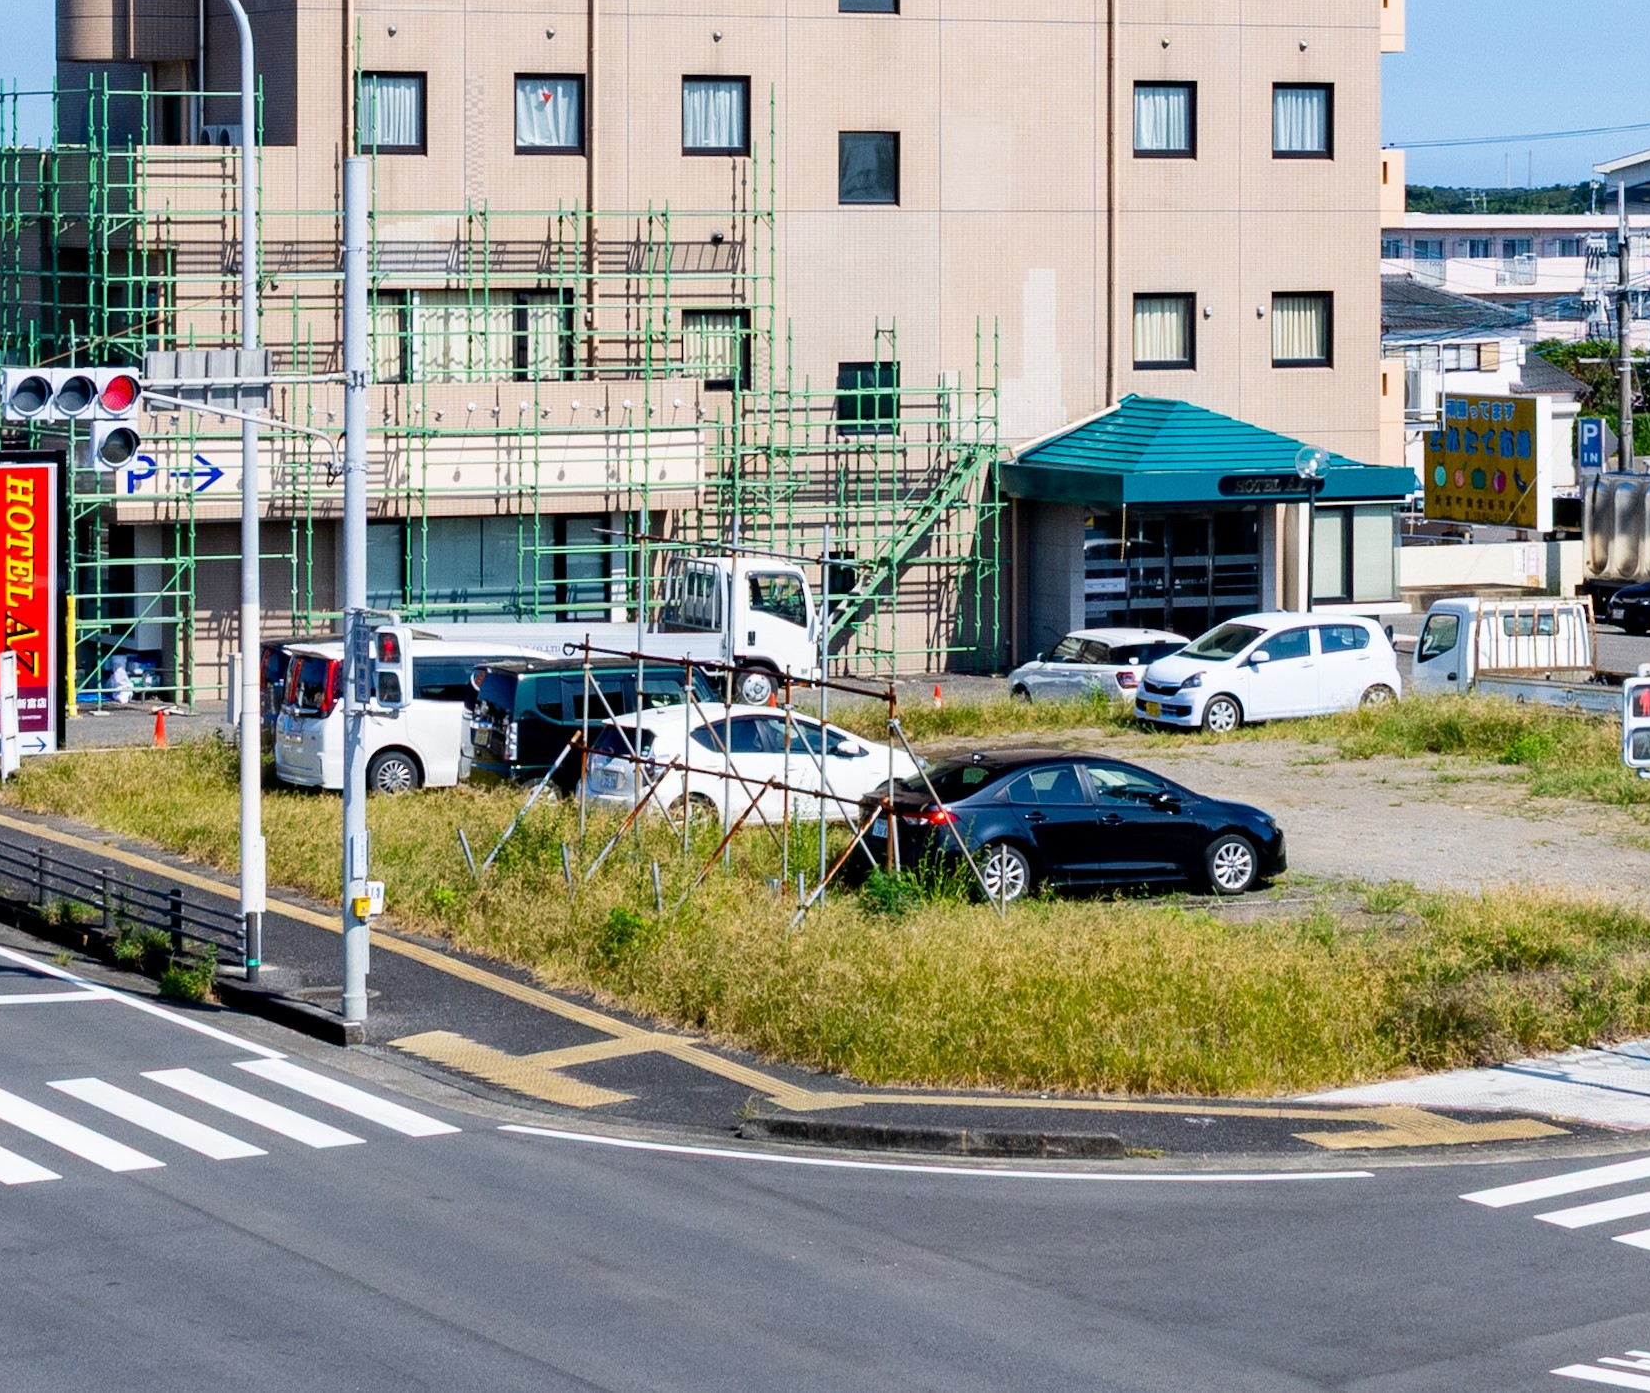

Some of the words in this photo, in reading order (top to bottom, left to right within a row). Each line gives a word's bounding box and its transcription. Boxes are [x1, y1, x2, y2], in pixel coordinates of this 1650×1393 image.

[1583, 423, 1598, 445] P
[1583, 452, 1598, 463] IN
[5, 474, 36, 608] HOTEL
